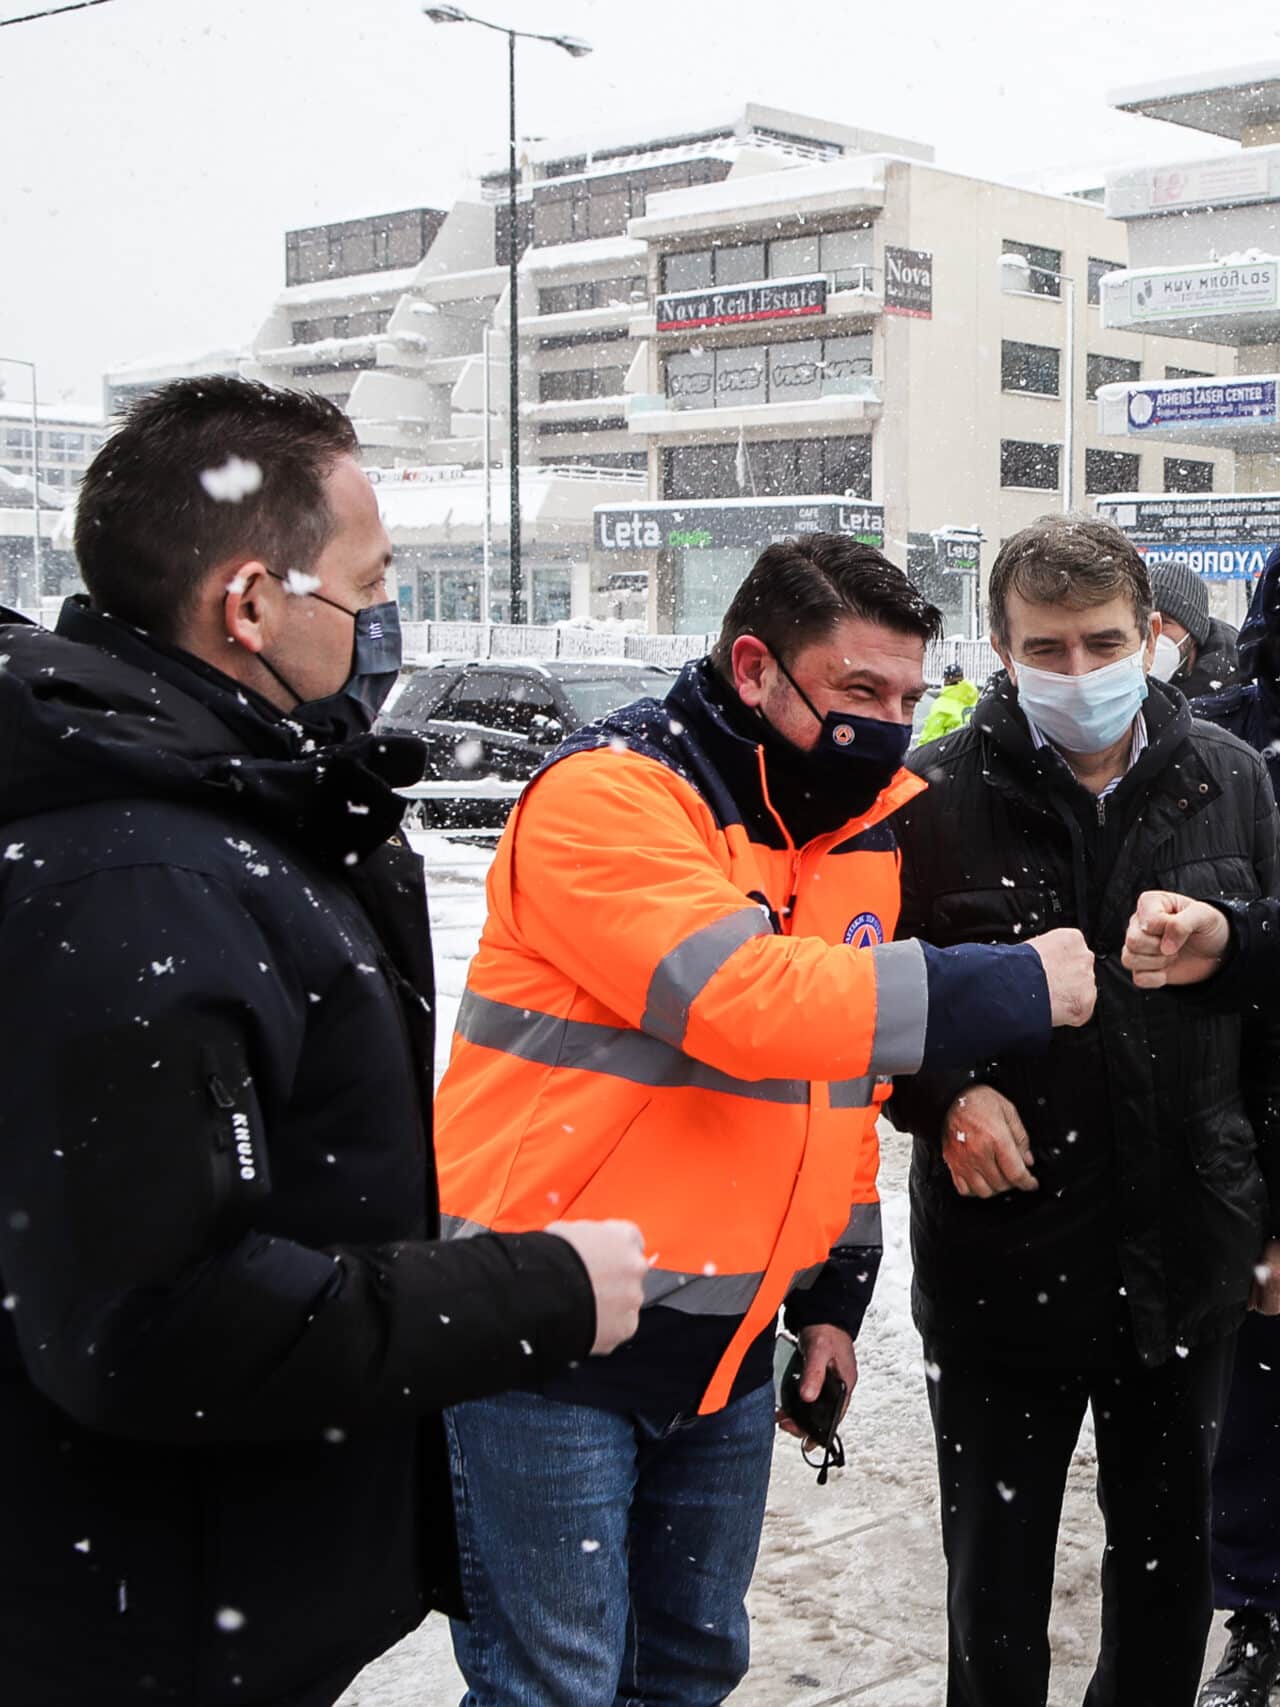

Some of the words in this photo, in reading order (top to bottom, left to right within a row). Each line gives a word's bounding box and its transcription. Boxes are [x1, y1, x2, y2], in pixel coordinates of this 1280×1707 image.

[886, 258, 931, 287] Nova
[662, 300, 707, 322] Nova
[713, 290, 755, 316] Real
[758, 286, 817, 311] Estate
[1194, 388, 1223, 404] LASER
[1225, 385, 1263, 402] CENTER
[601, 513, 660, 547] Leta
[839, 507, 882, 531] Leta
[231, 1113, 256, 1180] KNUJO
